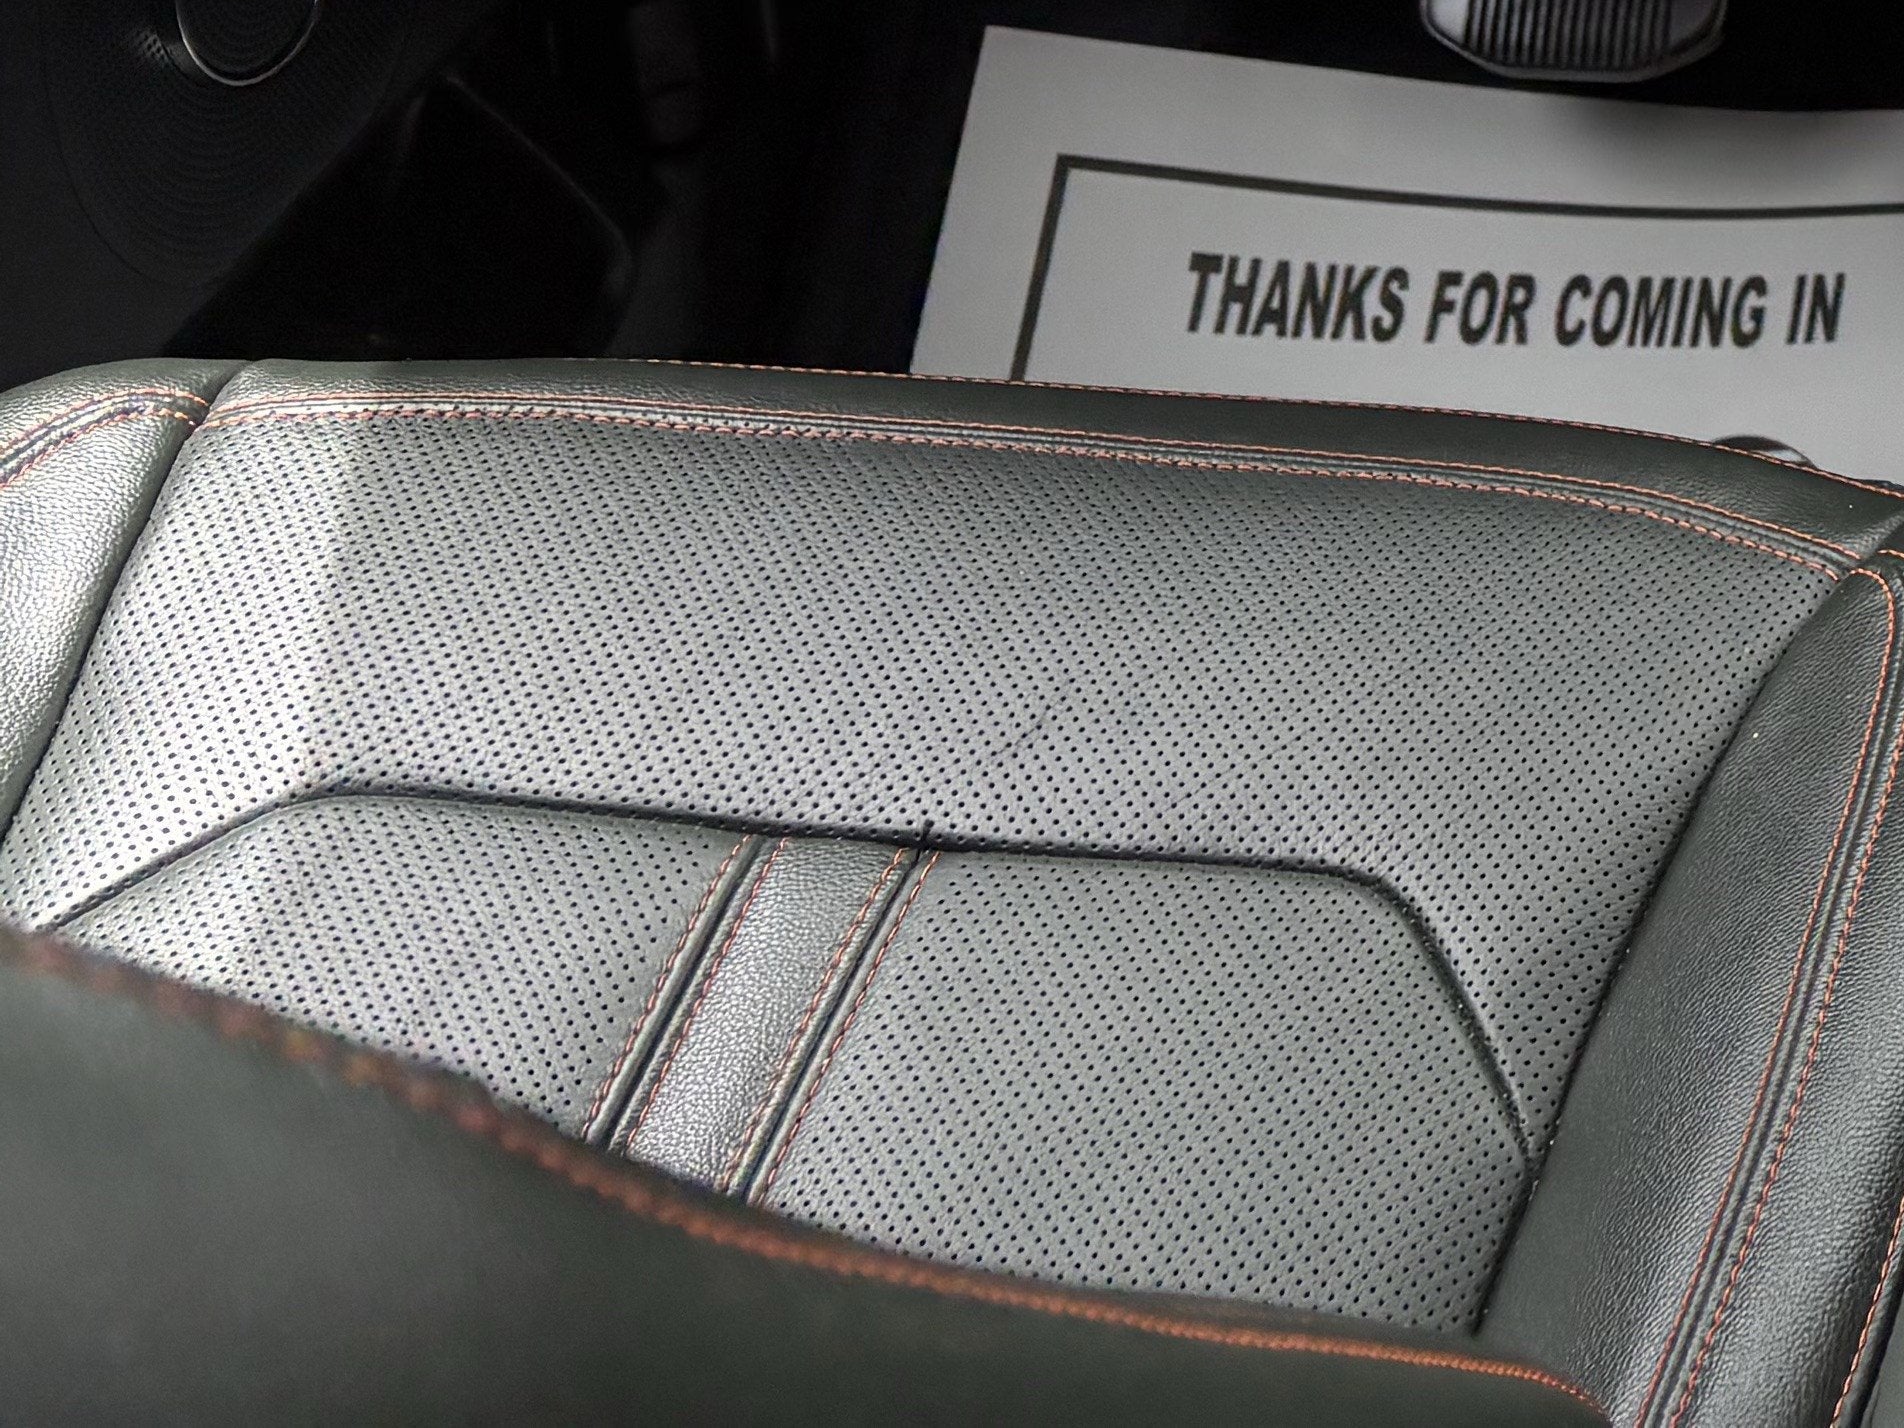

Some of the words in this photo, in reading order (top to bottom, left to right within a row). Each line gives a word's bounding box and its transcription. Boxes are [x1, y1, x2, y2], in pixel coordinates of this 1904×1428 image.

[1185, 250, 1410, 345] THANKS
[1424, 269, 1538, 342] FOR
[1553, 272, 1767, 350] COMING
[1786, 272, 1847, 346] IN
